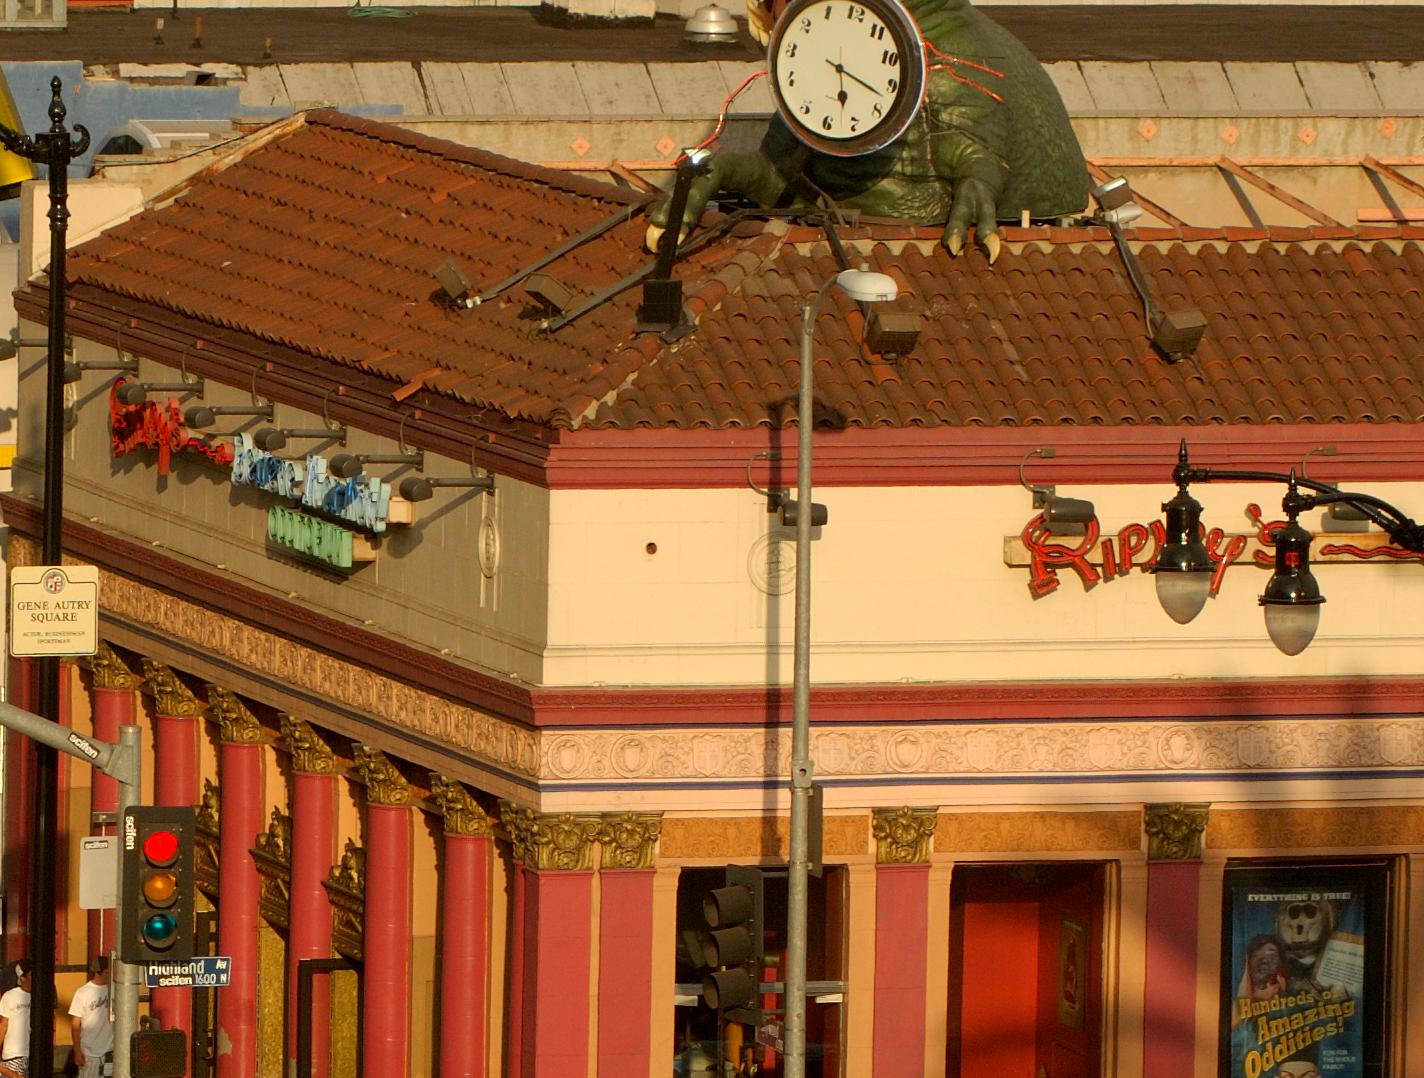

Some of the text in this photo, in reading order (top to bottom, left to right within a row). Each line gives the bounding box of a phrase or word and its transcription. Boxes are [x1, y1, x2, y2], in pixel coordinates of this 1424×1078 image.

[882, 49, 899, 67] 10
[872, 102, 882, 119] 8
[822, 115, 833, 131] 6
[17, 600, 92, 611] GENE AUTRY
[31, 612, 77, 624] SQUARE
[125, 815, 136, 850] scifen
[159, 975, 192, 987] scifen
[195, 973, 227, 985] 1600 N
[1239, 991, 1314, 1019] Hundreds
[1257, 1000, 1356, 1045] Amazing
